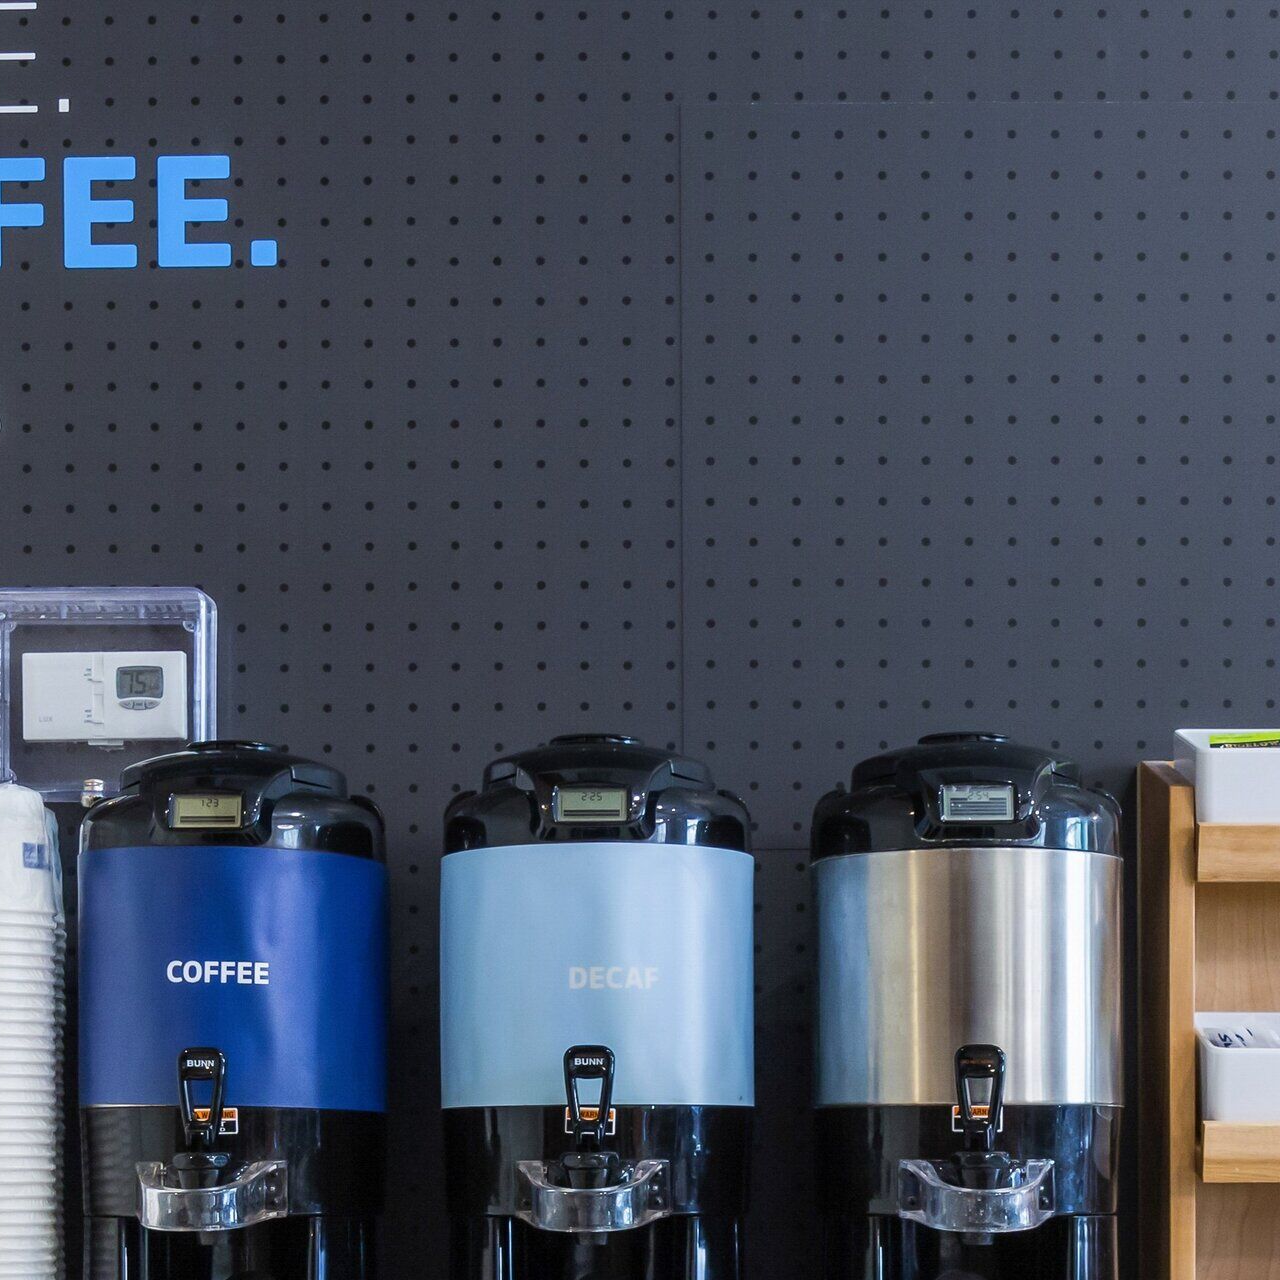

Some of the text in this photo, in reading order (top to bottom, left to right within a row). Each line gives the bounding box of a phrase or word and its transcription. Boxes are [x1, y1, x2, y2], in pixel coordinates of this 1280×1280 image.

[122, 670, 146, 694] 75
[166, 959, 270, 985] COFFEE
[568, 966, 659, 990] DECAF
[186, 1059, 215, 1068] BUNN
[574, 1057, 604, 1066] BUNN
